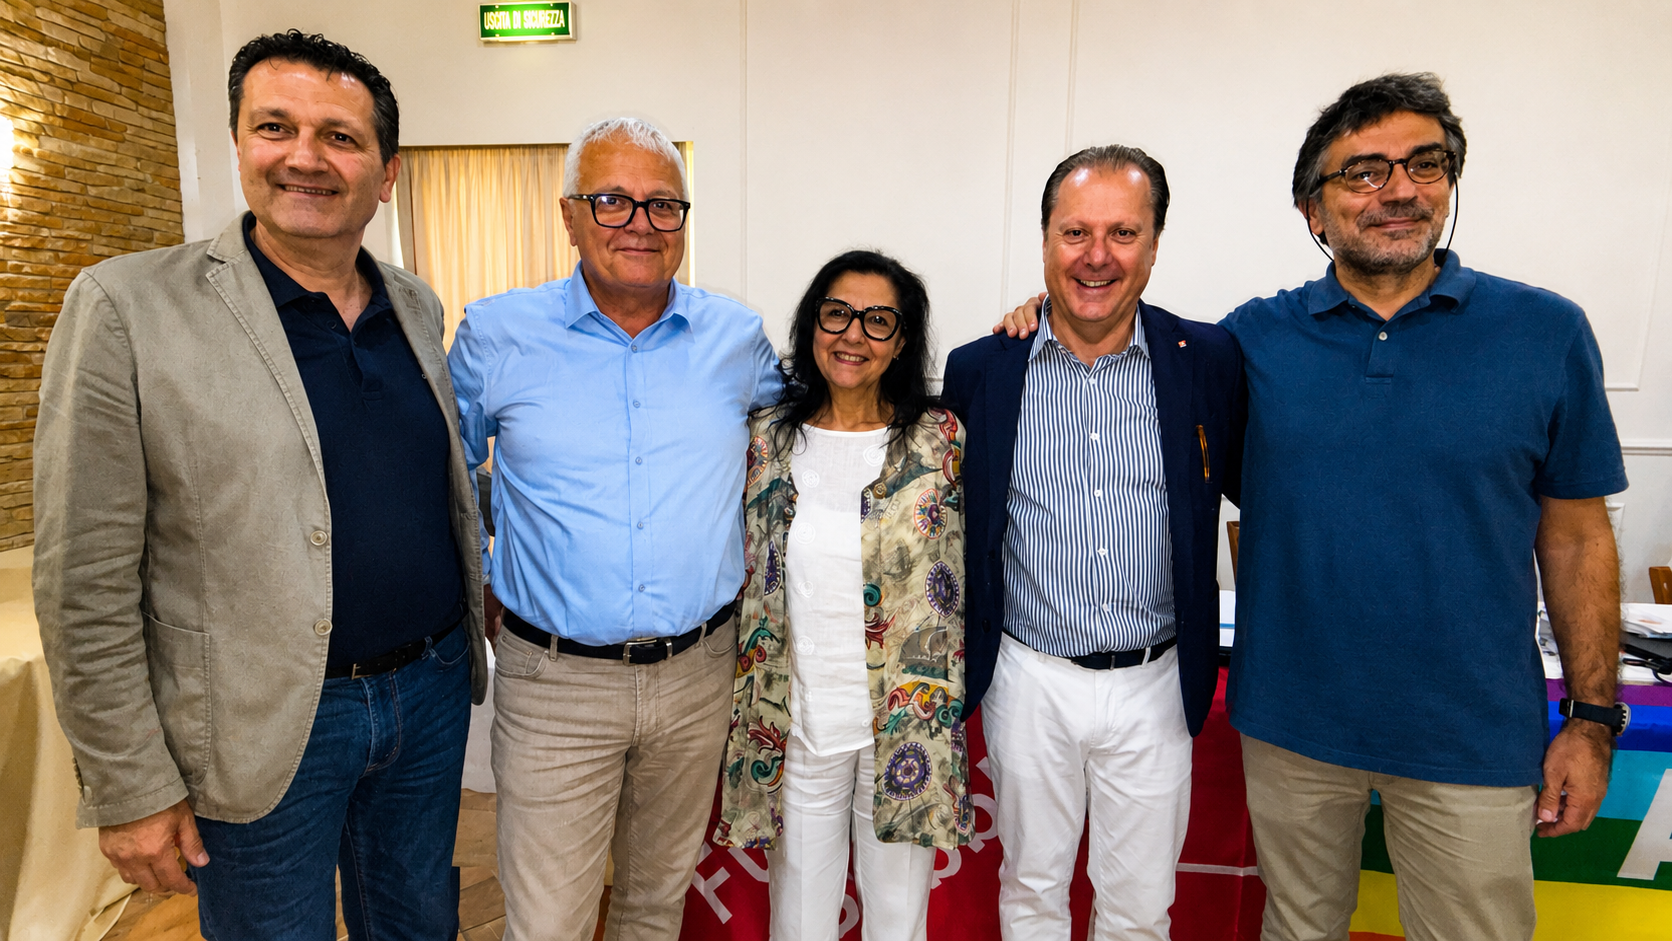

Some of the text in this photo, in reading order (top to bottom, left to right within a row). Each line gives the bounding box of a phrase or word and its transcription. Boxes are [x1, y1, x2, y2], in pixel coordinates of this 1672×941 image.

[484, 10, 565, 30] USCITA DI SICUREZZA
